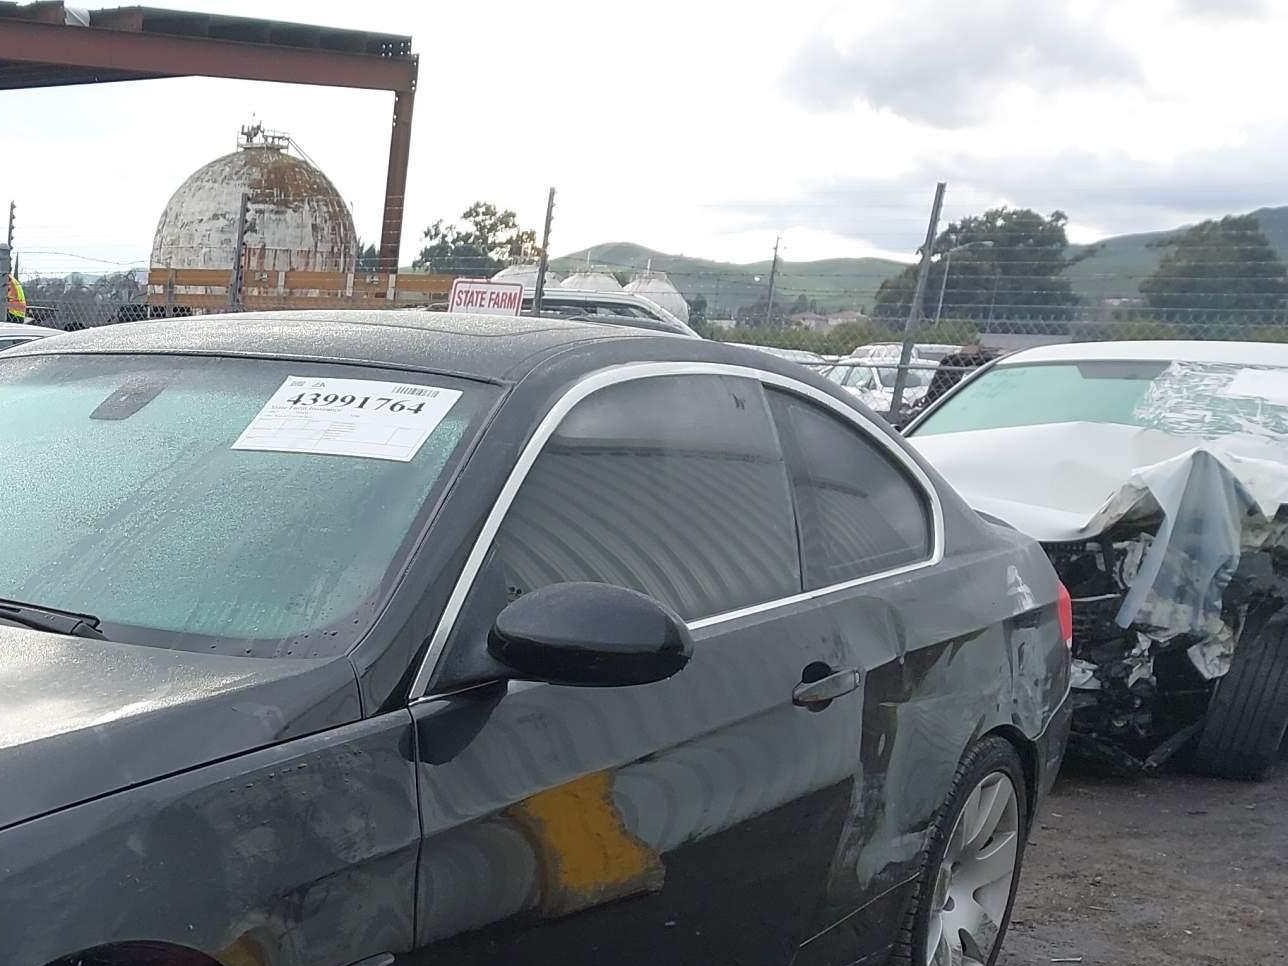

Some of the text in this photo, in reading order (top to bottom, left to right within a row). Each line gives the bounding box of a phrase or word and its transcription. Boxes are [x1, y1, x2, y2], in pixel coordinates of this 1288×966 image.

[456, 290, 517, 309] STATE FARM
[287, 392, 426, 414] 43991764
